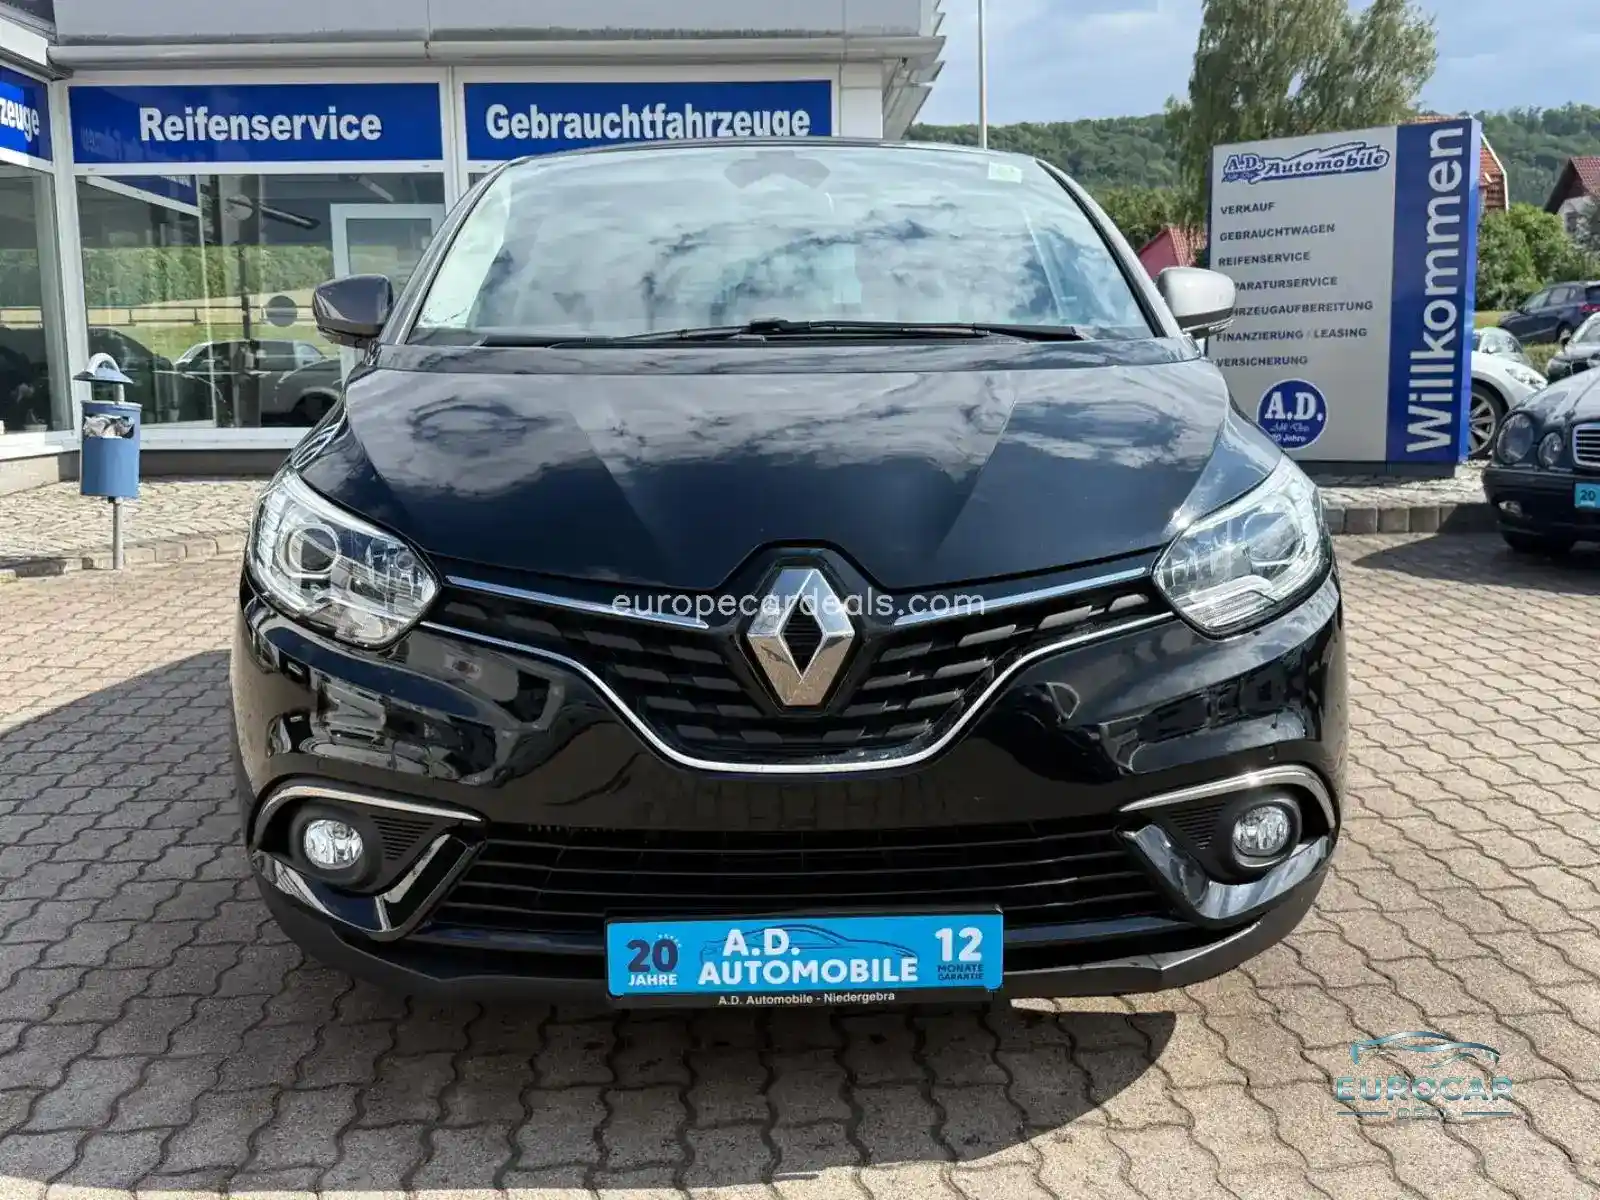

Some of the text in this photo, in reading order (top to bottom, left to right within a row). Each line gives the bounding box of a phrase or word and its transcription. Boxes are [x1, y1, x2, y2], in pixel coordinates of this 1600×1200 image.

[139, 105, 382, 143] Reifenservice
[486, 103, 811, 139] Gebrauchtfahrzeuge
[1227, 148, 1386, 175] A.D. Automobile
[1220, 201, 1276, 215] VERKAUF
[1220, 223, 1336, 241] GEBRAUCHTWAGEN
[1218, 251, 1311, 267] REIFENSERVICE
[1406, 127, 1464, 454] Willkommen
[1216, 330, 1304, 342] FINANZIERUNG
[1313, 327, 1368, 340] LEASING
[1216, 355, 1308, 368] VERSICHERUNG
[1264, 391, 1323, 421] A.D.
[1579, 489, 1597, 501] 20
[722, 928, 800, 956] A.D.
[935, 927, 984, 962] 12
[626, 938, 679, 973] 20
[698, 956, 918, 986] AUTOMOBILE
[937, 963, 984, 974] MONATE
[937, 972, 984, 982] GARANTIE
[627, 973, 678, 987] JAHRE
[718, 995, 743, 1007] A.D.
[748, 993, 813, 1006] Automobile
[823, 991, 896, 1006] Niedergebra
